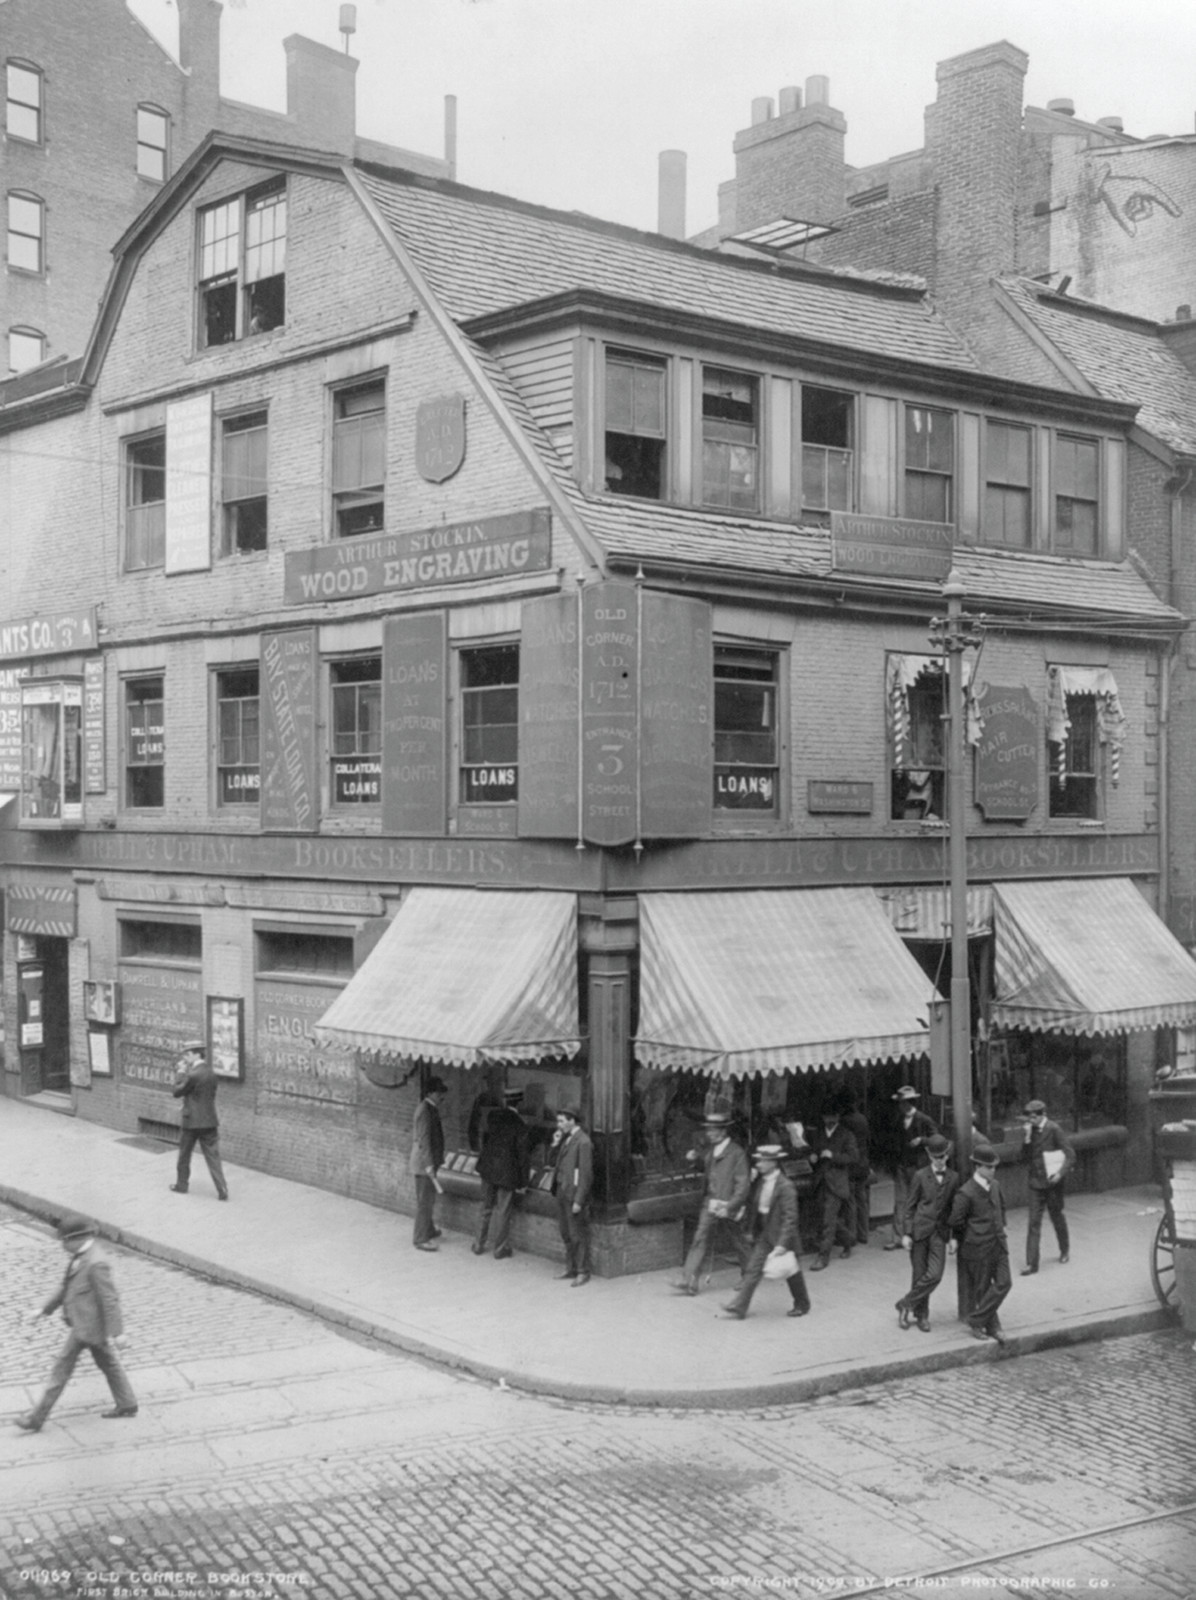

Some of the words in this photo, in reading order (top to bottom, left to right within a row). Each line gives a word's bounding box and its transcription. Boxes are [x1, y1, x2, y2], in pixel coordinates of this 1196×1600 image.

[836, 519, 887, 536] ARTHUR
[334, 539, 397, 565] ARTHUR
[838, 547, 874, 563] WOOD
[301, 566, 368, 598] WOOD
[384, 539, 530, 586] ENGRAVING
[594, 608, 626, 621] OLD
[0, 625, 29, 654] NTS
[31, 620, 54, 650] CO.
[62, 628, 73, 648] 3
[389, 661, 438, 684] LOANS
[403, 695, 420, 707] AT
[979, 731, 1008, 759] HAIR
[335, 763, 382, 774] COLLATERA
[597, 744, 624, 776] 3
[228, 774, 260, 789] LOANS
[471, 768, 515, 786] LOANS
[718, 775, 768, 793] LOANS
[343, 781, 378, 795] LOANS
[587, 783, 633, 795] SCHOOL
[589, 805, 631, 817] STREET
[295, 839, 514, 874] BOOKSELLERS.
[267, 1014, 312, 1038] ENGL
